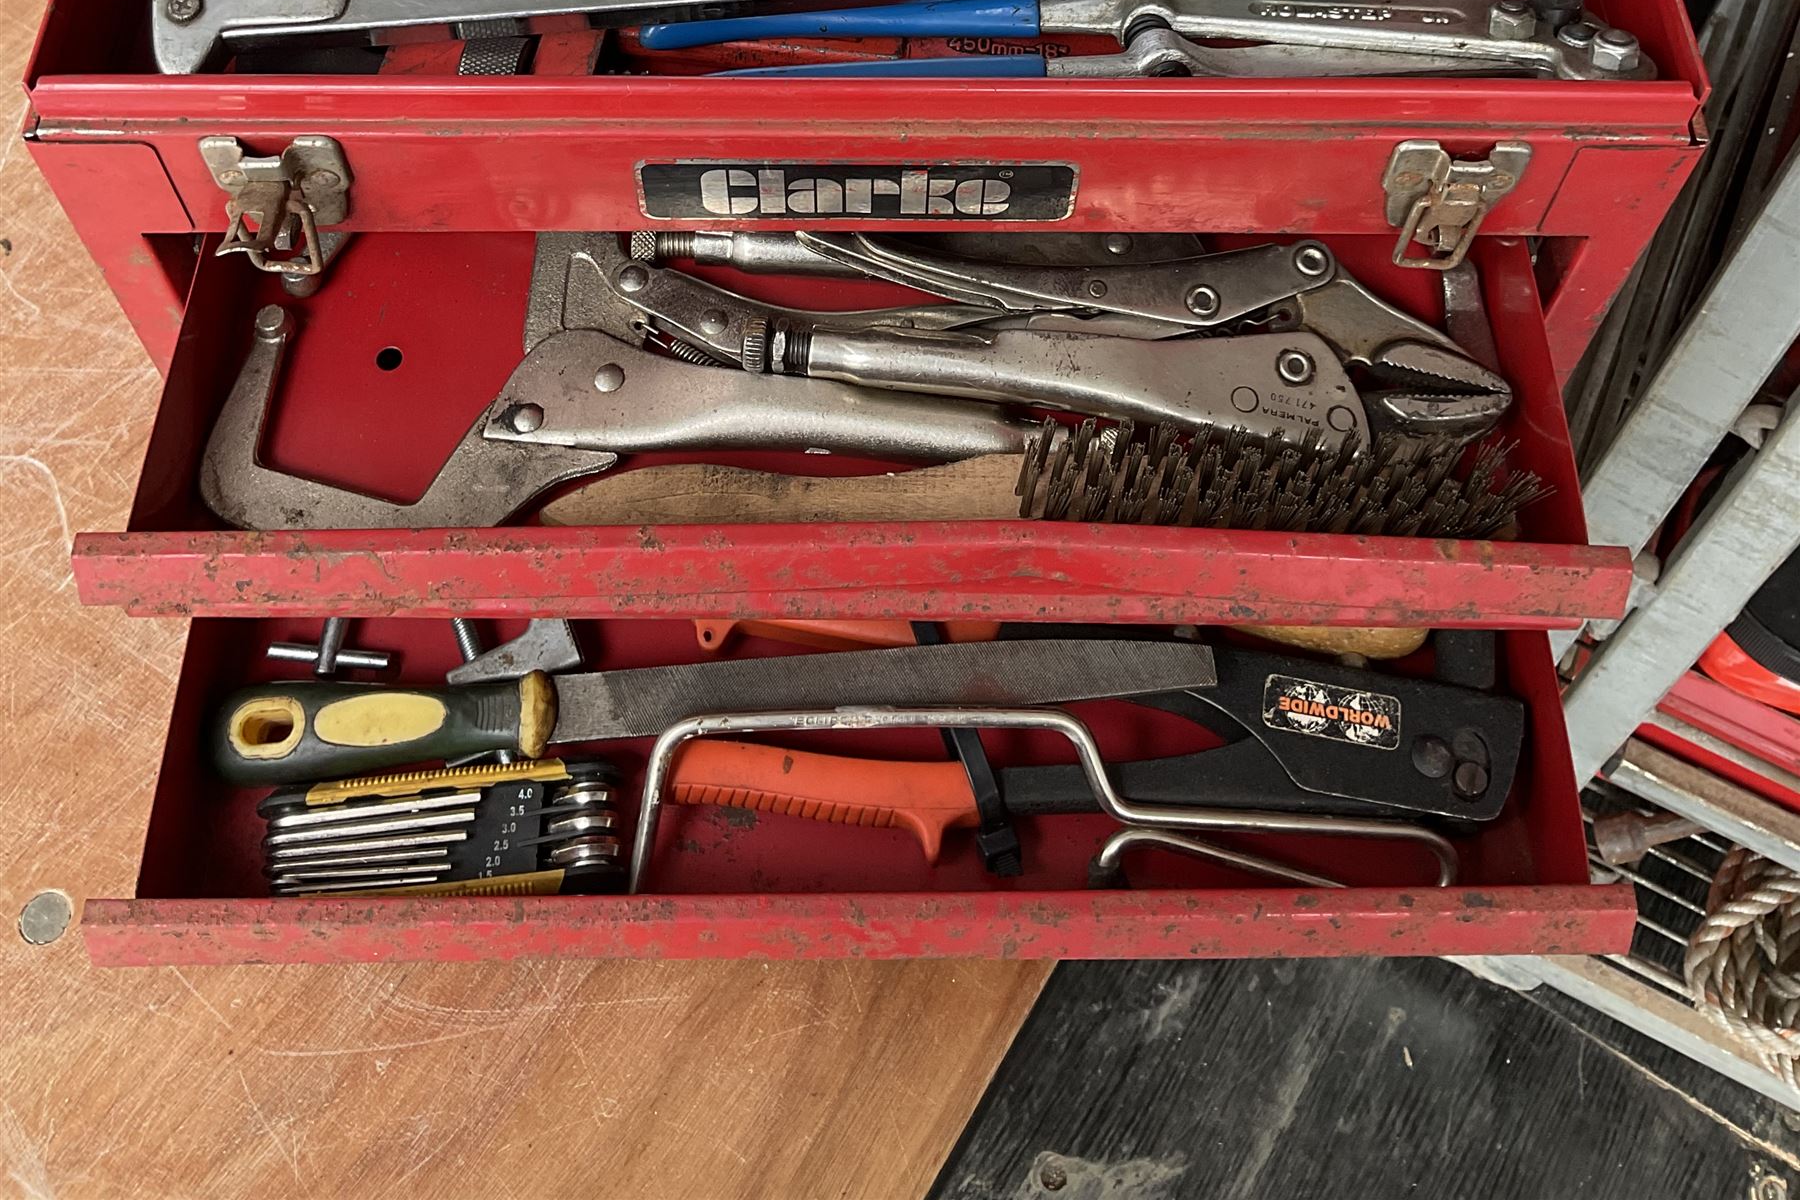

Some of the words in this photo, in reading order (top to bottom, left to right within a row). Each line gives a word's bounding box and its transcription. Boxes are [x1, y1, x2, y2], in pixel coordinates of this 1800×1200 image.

[700, 168, 1011, 216] Clarke
[1261, 406, 1320, 427] PALMERA
[1278, 695, 1394, 730] WORLDWIDE
[518, 787, 533, 800] 4.0
[510, 805, 525, 817] 3.5
[502, 822, 517, 834] 3.0
[494, 839, 509, 851] 2.5
[485, 856, 501, 868] 2.0
